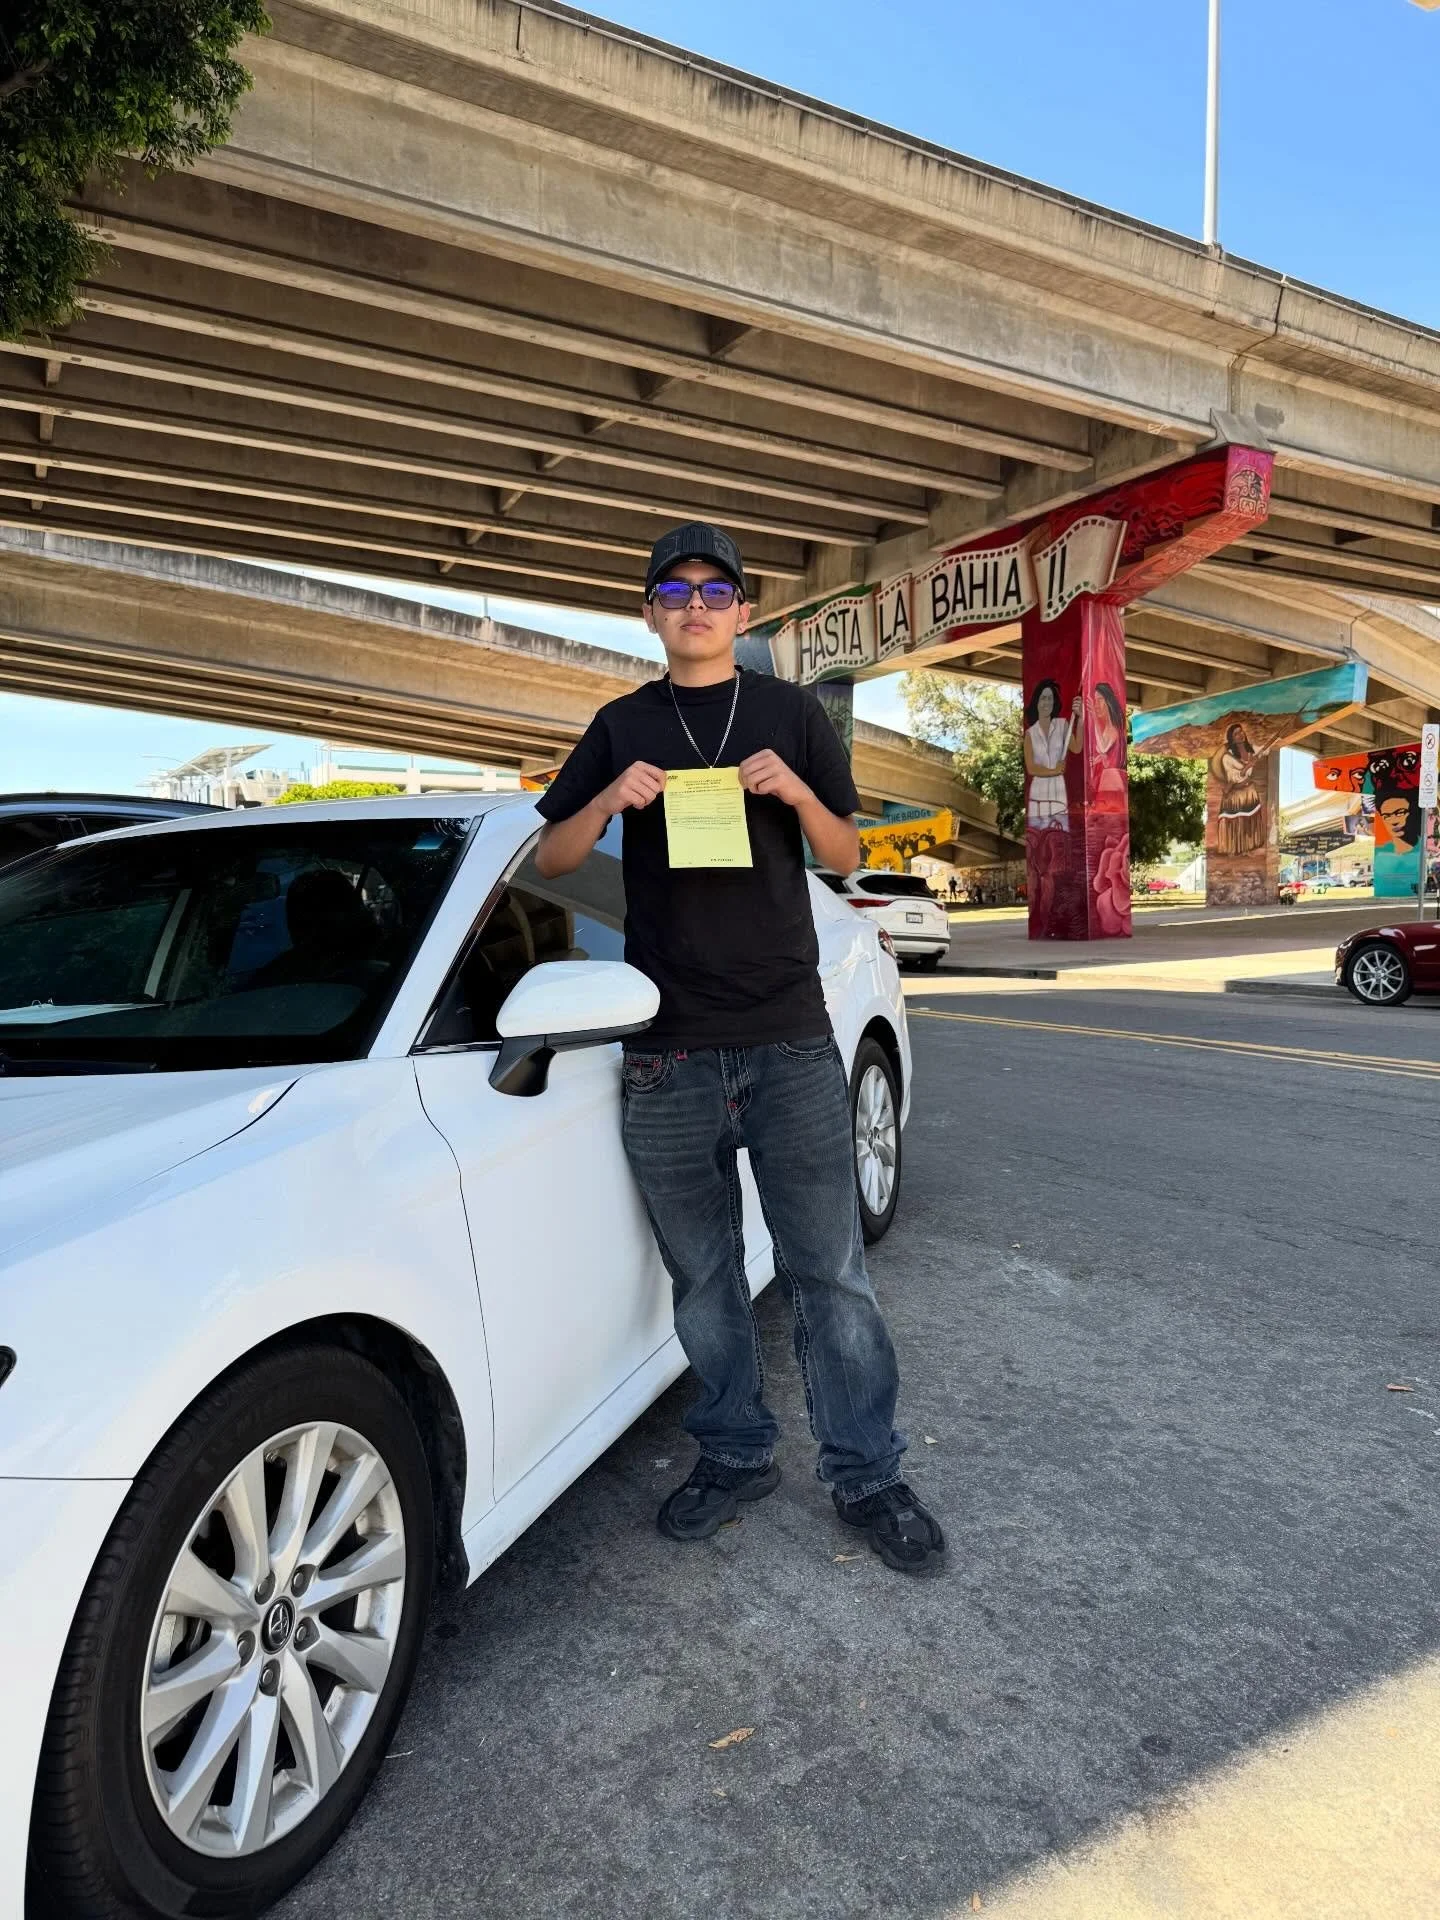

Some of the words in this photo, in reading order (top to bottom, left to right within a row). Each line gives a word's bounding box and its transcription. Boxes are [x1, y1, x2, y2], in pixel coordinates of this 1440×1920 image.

[799, 607, 863, 674] HASTA
[879, 589, 909, 647] LA
[930, 557, 1022, 624] BAHIA
